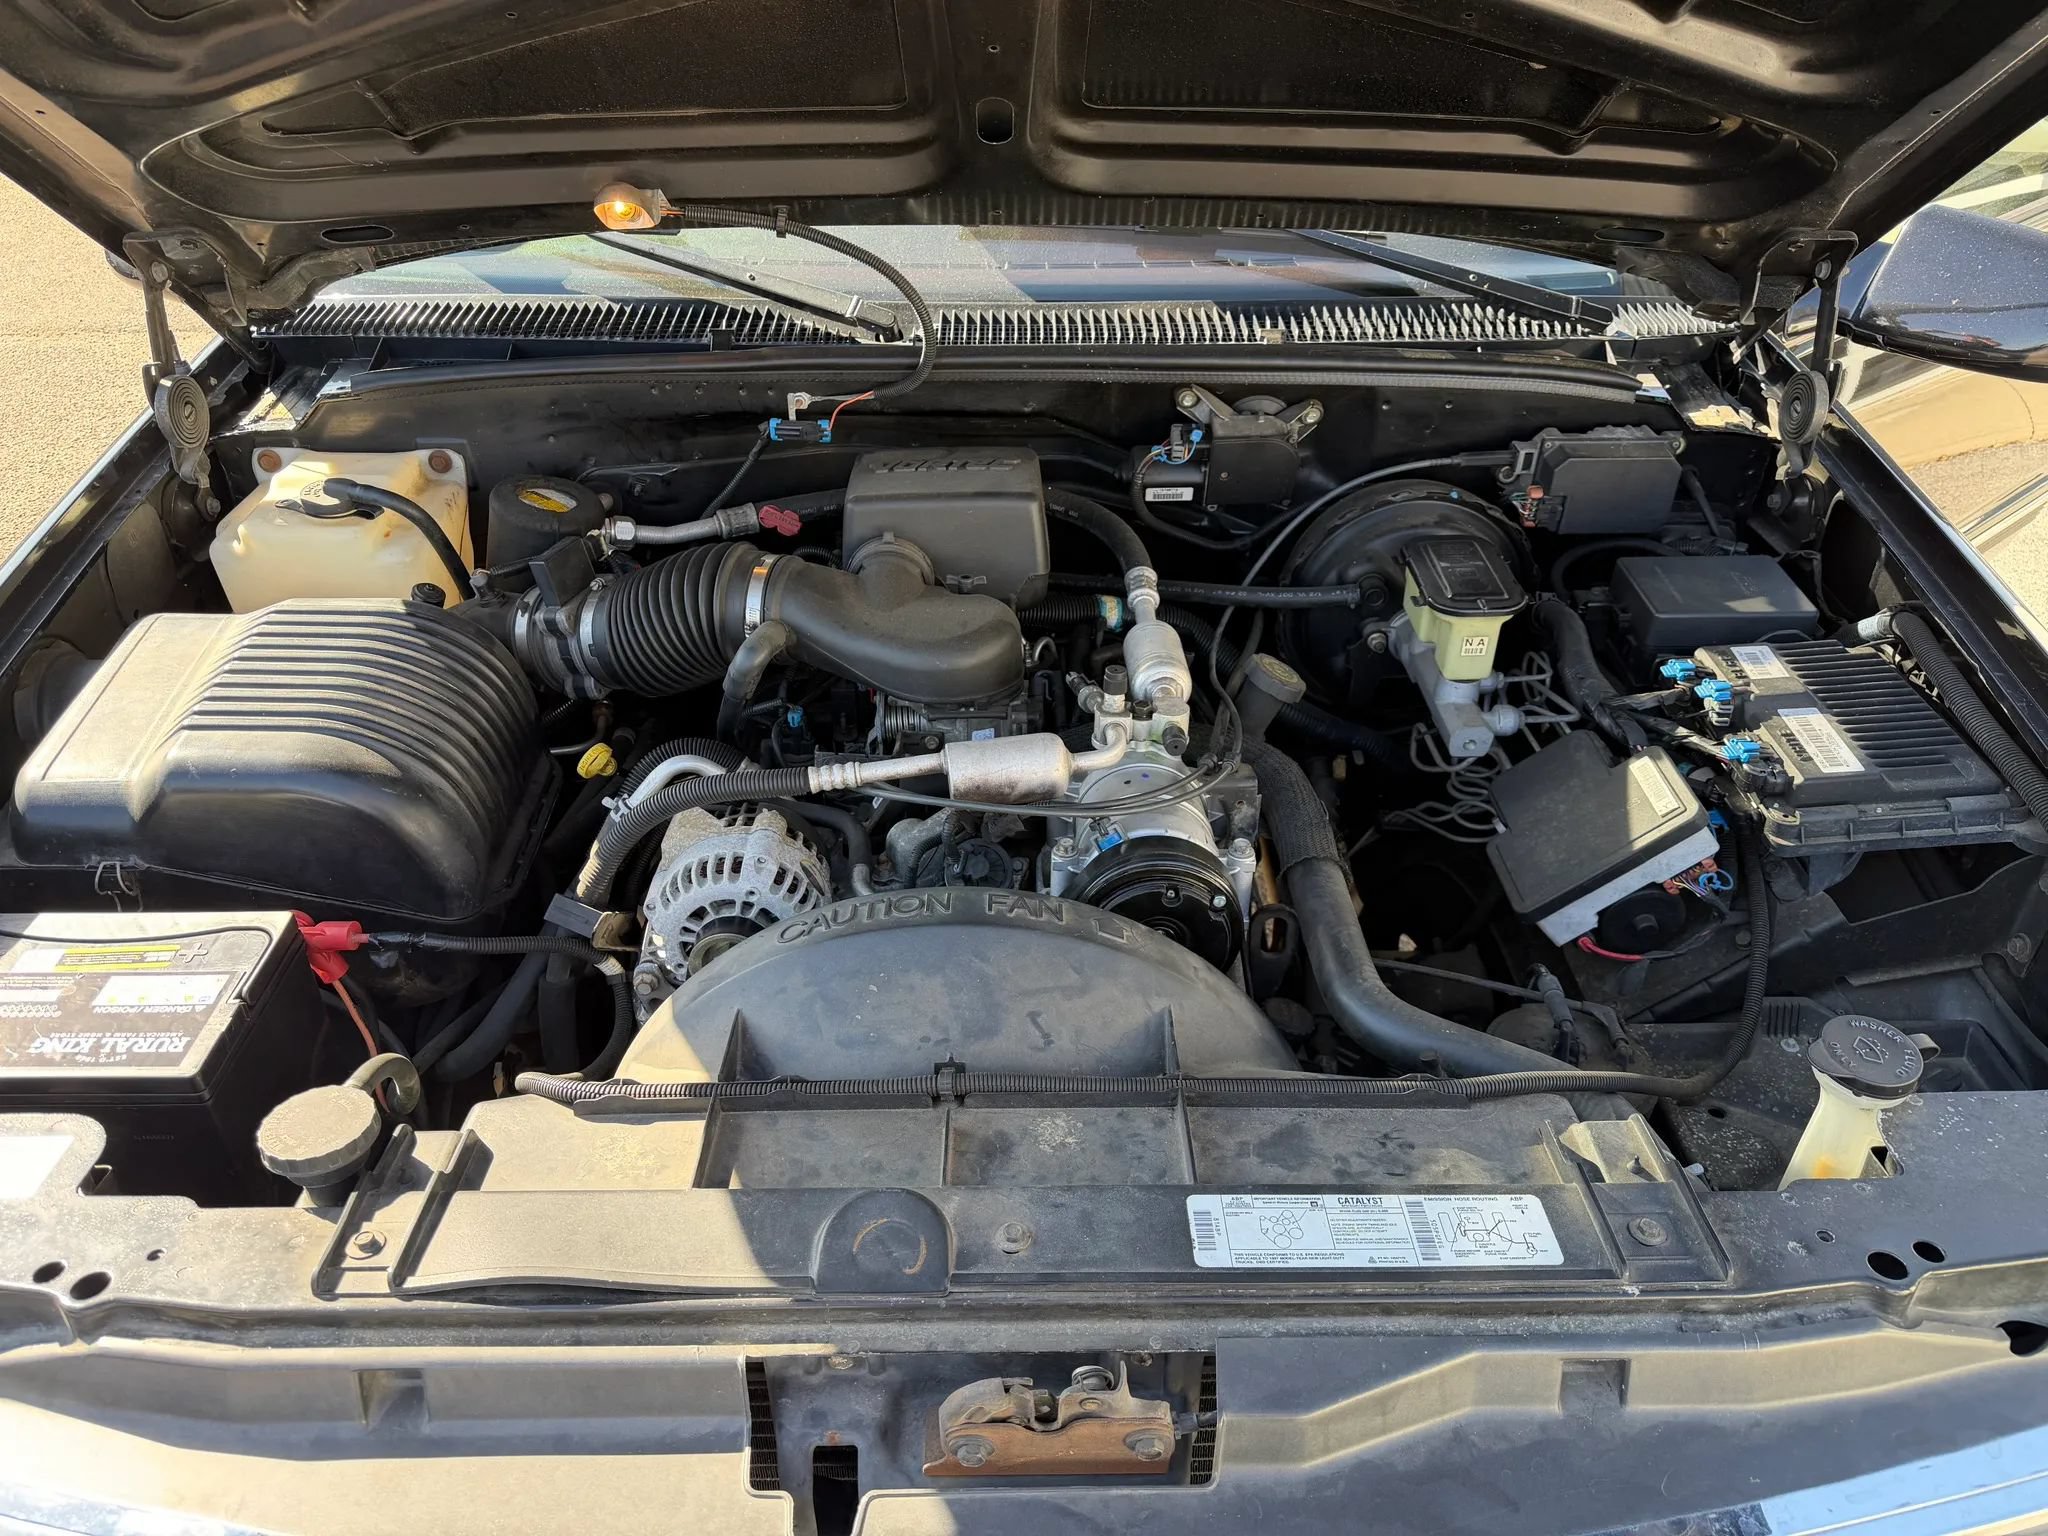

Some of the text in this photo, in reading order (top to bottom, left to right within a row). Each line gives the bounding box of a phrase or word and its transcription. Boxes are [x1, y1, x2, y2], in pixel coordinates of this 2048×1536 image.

[776, 892, 1064, 944] CAUTION FAN
[27, 1036, 191, 1053] RURAL KING
[1829, 1041, 1857, 1069] ONLY
[1849, 1019, 1917, 1077] WASHER FLUID
[1337, 1197, 1383, 1205] CATALYST
